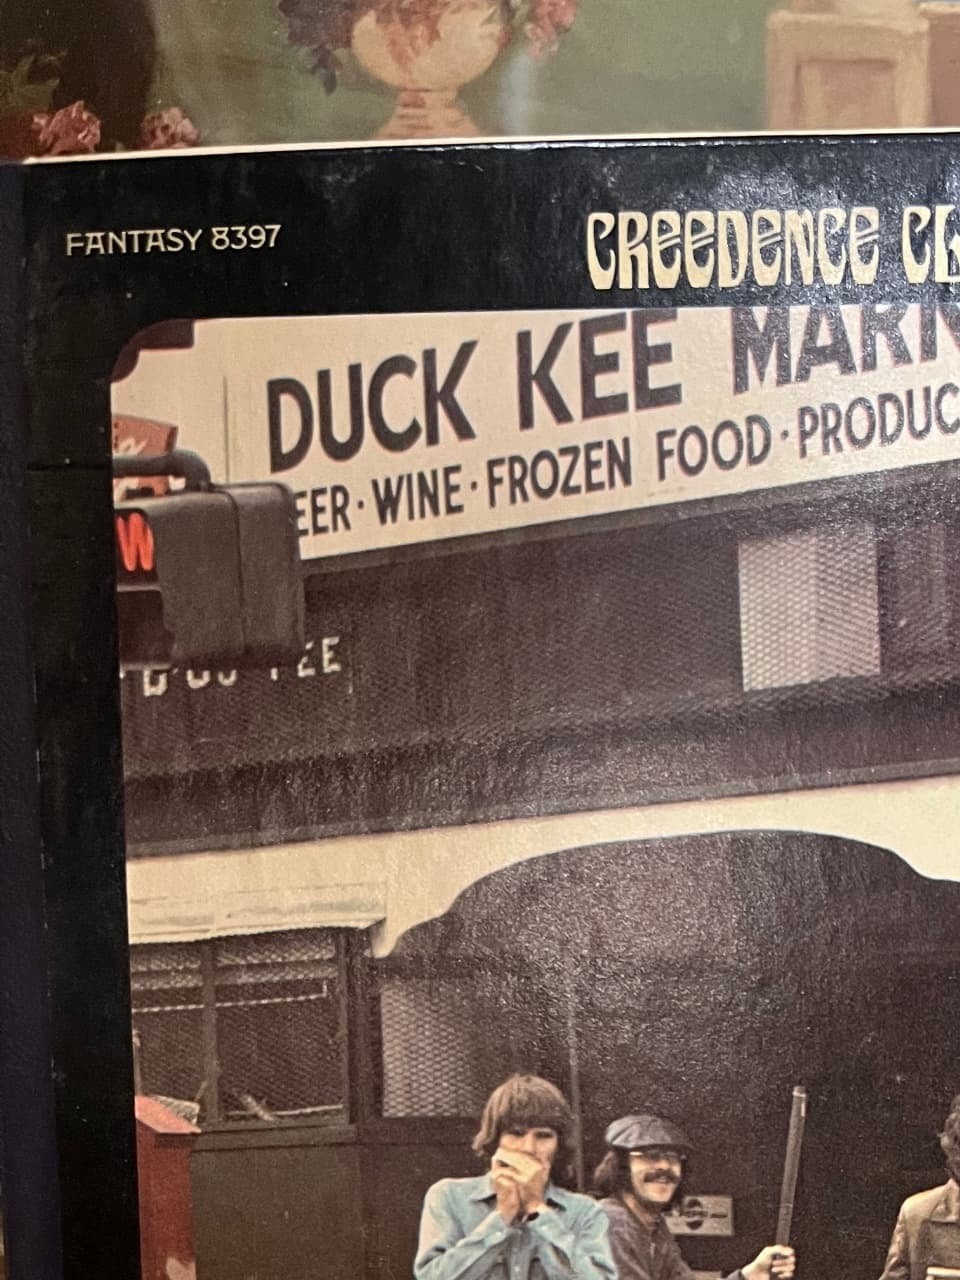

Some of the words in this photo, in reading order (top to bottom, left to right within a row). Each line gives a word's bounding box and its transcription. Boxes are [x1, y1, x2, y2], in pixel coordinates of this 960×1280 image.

[66, 228, 202, 256] FANTASY
[211, 224, 282, 250] 8397
[585, 206, 880, 290] CREEDENCE
[266, 339, 478, 473] DUCK
[516, 309, 682, 431] KEE
[294, 485, 351, 537] EER
[371, 463, 465, 526] WINE
[487, 437, 632, 508] FROZEN
[656, 414, 772, 481] FOOD
